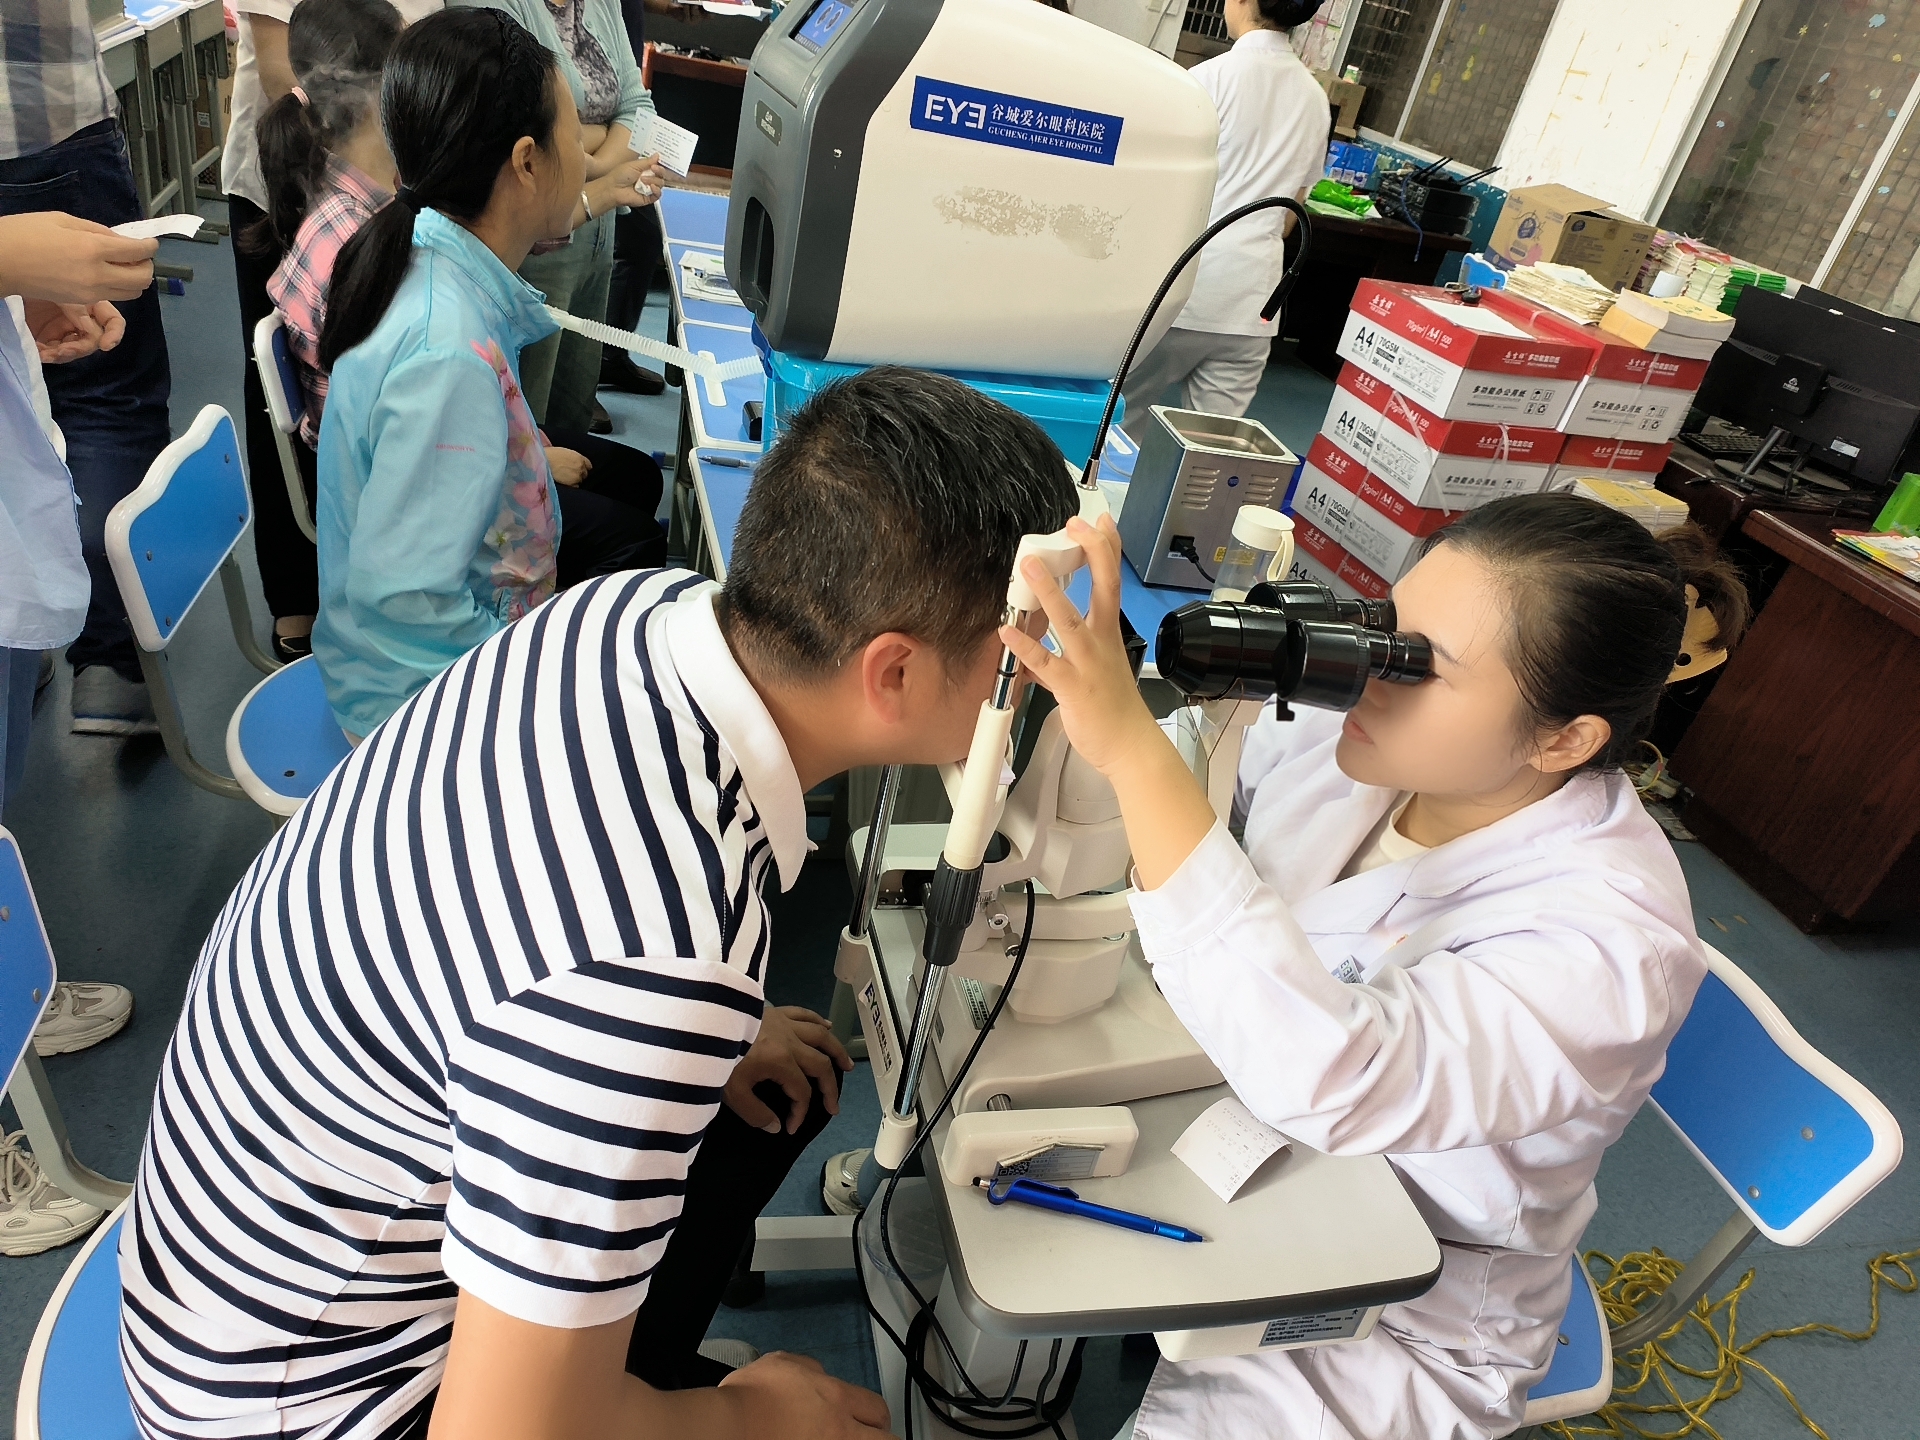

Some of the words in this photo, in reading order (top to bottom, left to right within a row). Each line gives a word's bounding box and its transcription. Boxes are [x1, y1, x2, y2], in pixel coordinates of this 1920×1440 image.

[990, 103, 1106, 141] 谷城爱尔眼科医院
[987, 126, 1028, 141] GUCHENG
[1028, 133, 1048, 146] AIER
[1048, 137, 1065, 149] EYE
[1065, 140, 1104, 155] HOSPITAL
[1355, 326, 1375, 348] A4
[1378, 336, 1400, 354] 70GSM
[1472, 385, 1527, 398] 多功能办公用纸
[1337, 410, 1356, 432] A4
[1308, 486, 1327, 508] A4
[1289, 561, 1308, 580] A4
